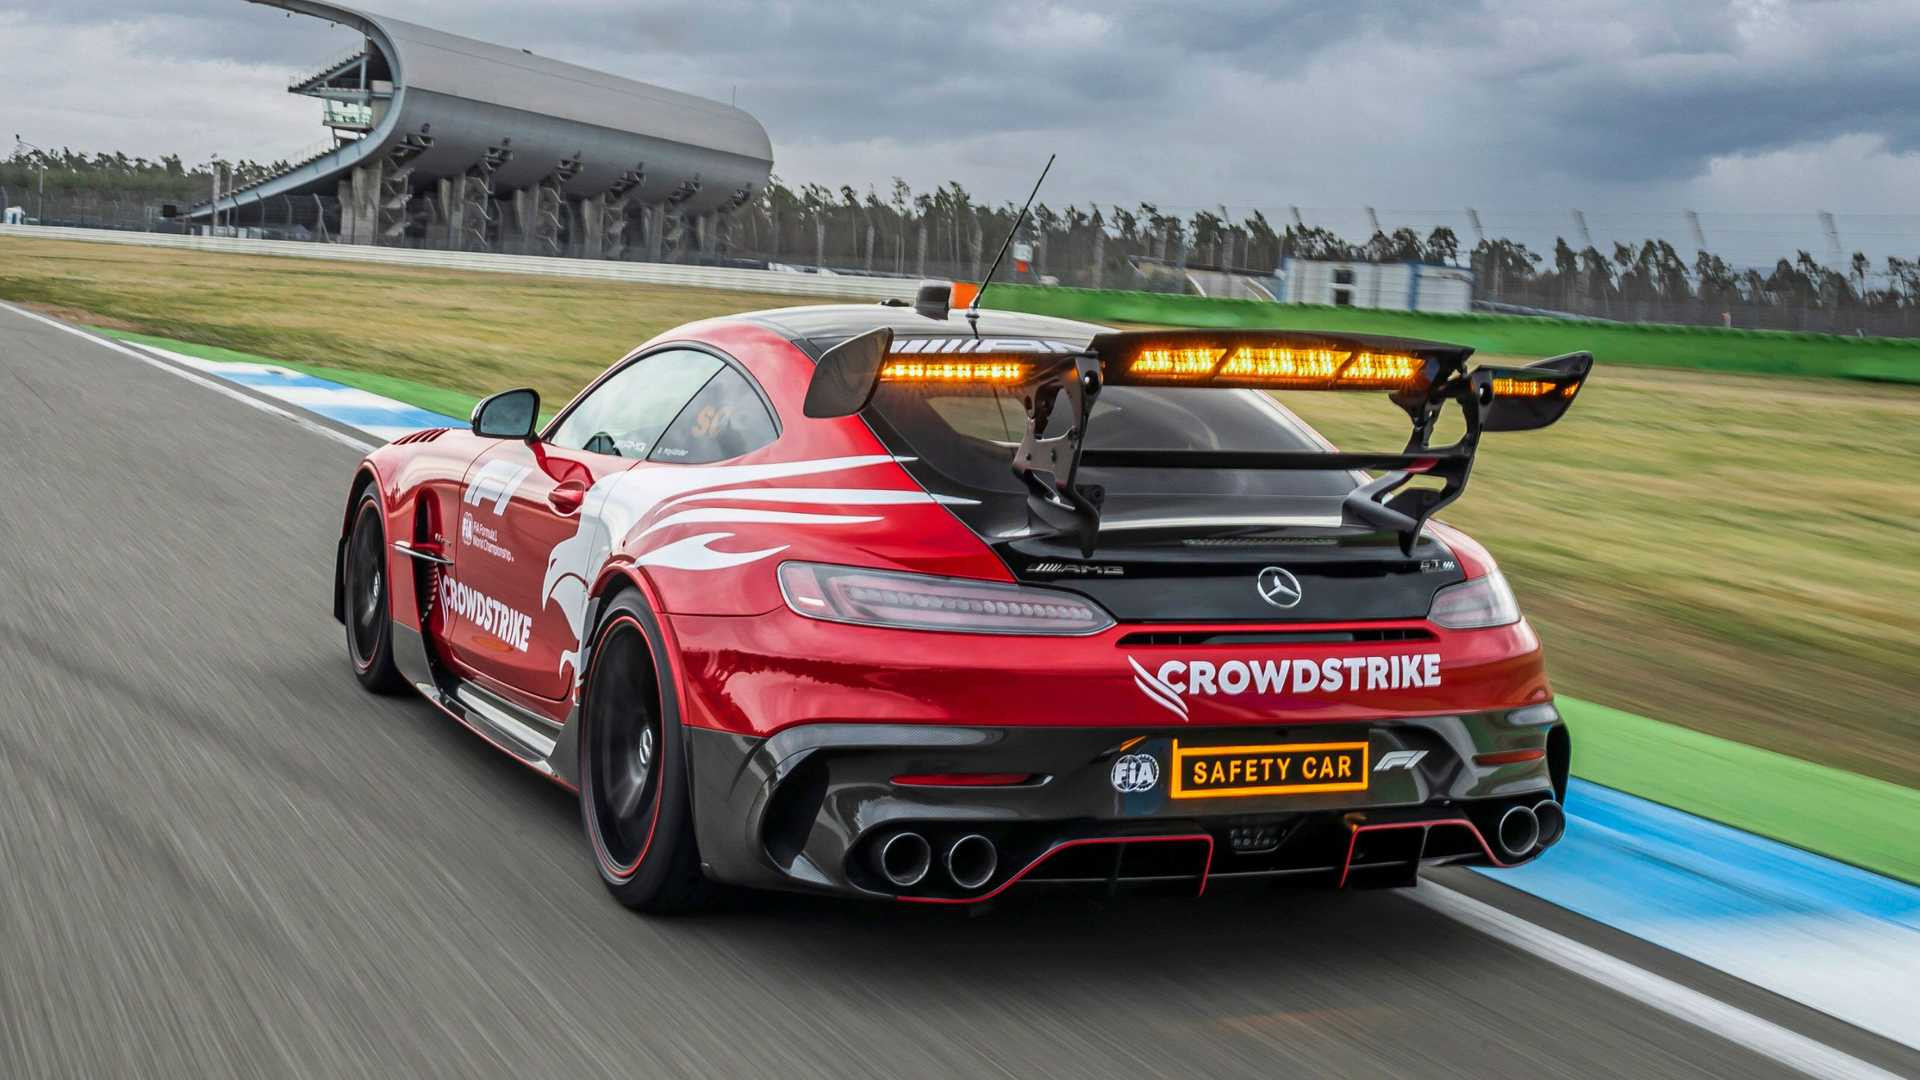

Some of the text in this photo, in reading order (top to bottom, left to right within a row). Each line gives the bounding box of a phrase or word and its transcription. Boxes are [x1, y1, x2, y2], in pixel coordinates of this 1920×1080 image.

[1061, 563, 1125, 576] AMG
[443, 574, 533, 653] CROWDSTRIKE
[1157, 653, 1442, 696] CROWDSTRIKE
[1192, 754, 1352, 785] SAFETY CAR
